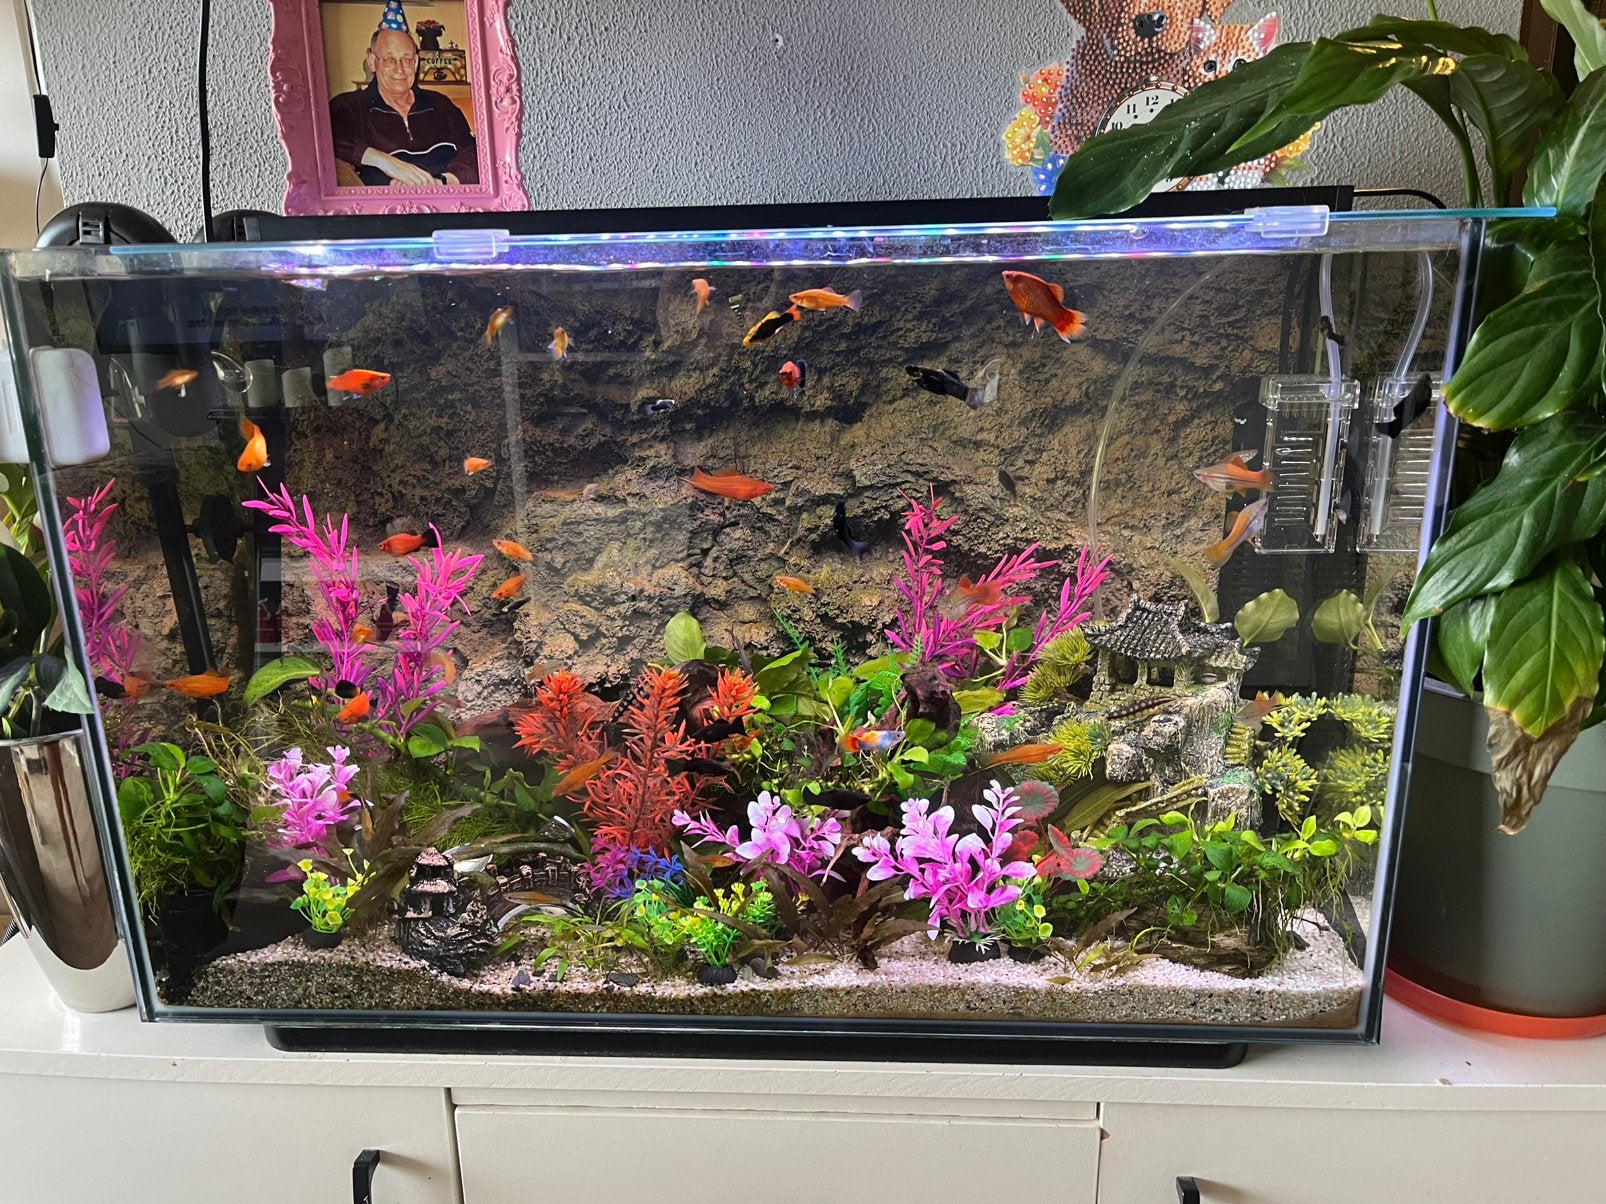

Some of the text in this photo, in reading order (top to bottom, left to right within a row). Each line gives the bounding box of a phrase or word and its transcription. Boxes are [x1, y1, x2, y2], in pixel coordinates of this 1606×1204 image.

[1146, 96, 1158, 106] 12
[1127, 104, 1136, 114] 11
[1112, 122, 1123, 130] 10
